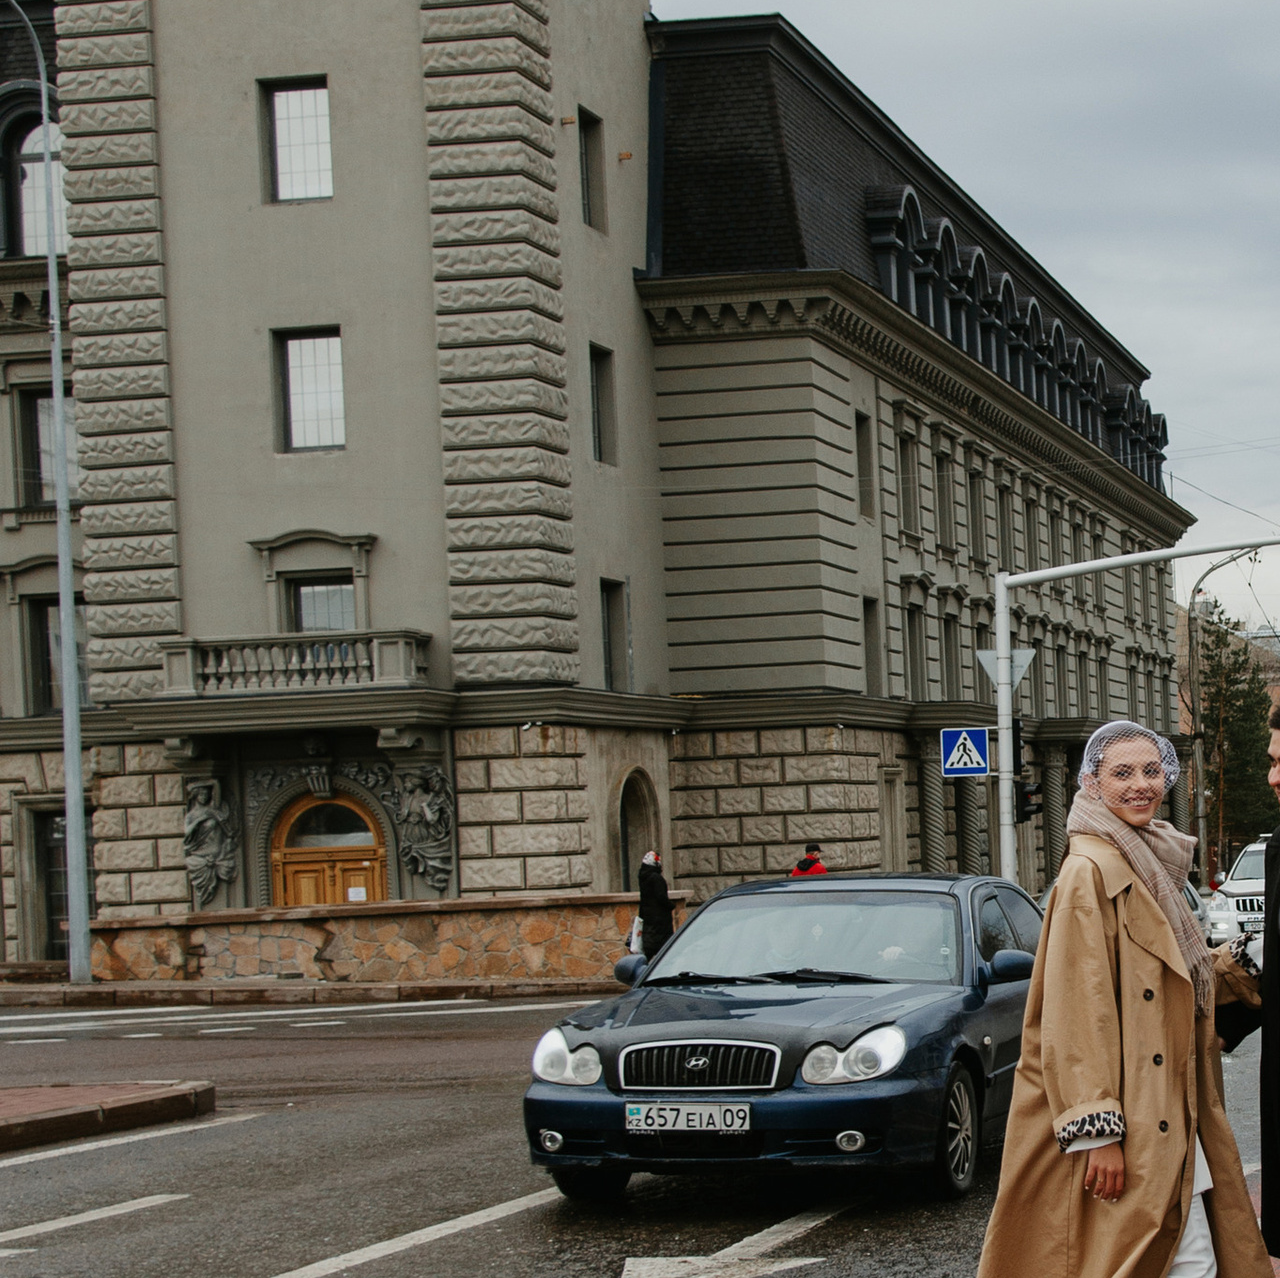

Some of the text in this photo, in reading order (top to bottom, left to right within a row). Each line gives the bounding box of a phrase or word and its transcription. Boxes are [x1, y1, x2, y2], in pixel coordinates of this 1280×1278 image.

[628, 1118, 641, 1127] KZ
[644, 1108, 747, 1129] 657 EIA 09
